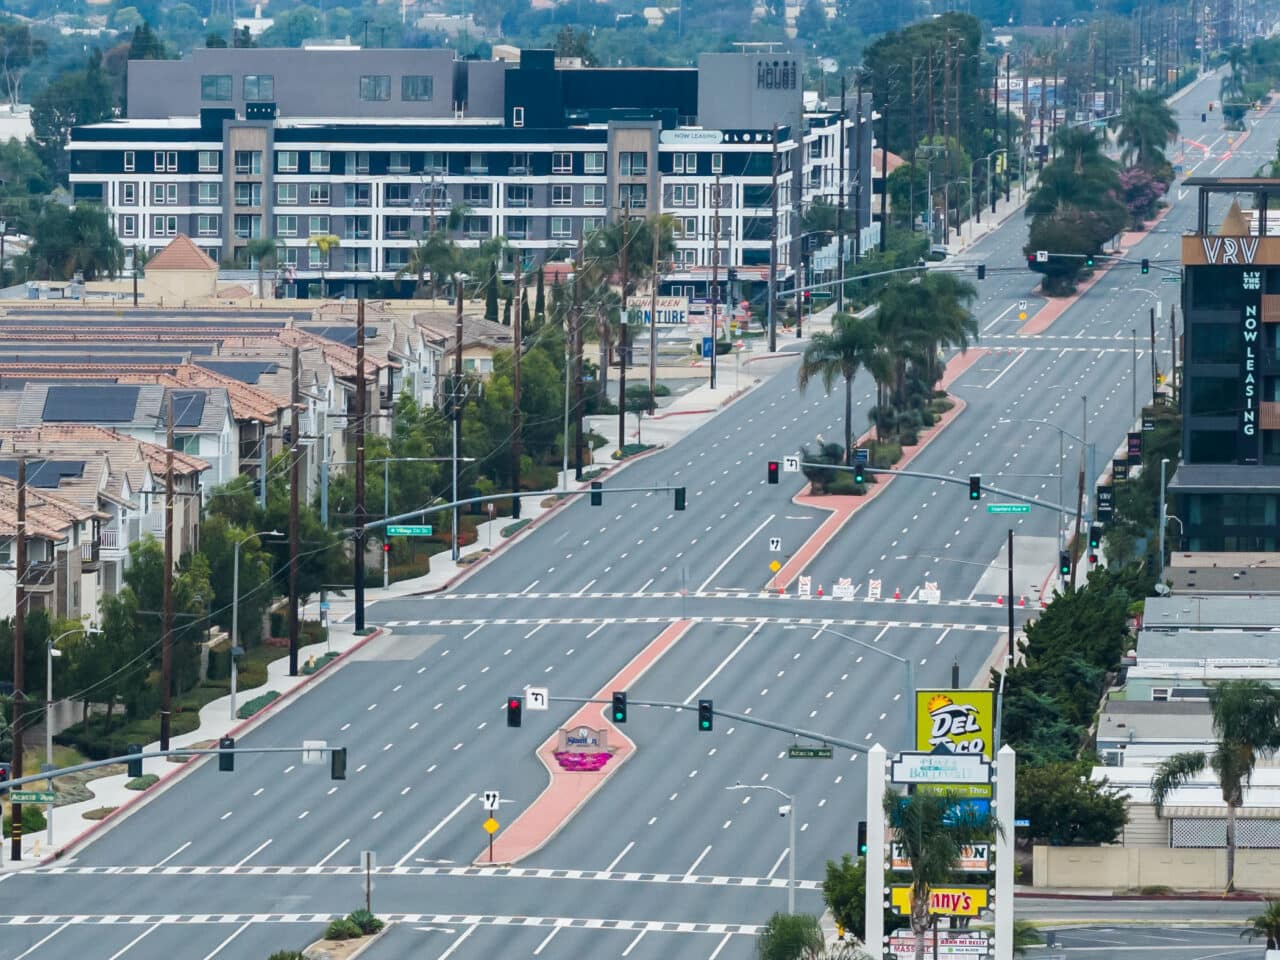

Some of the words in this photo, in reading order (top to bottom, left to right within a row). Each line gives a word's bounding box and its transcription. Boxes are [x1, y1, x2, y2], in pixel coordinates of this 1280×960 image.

[1202, 238, 1259, 264] VRV
[1243, 305, 1258, 341] NOW
[1243, 346, 1257, 435] LEASING
[931, 713, 981, 737] DEL
